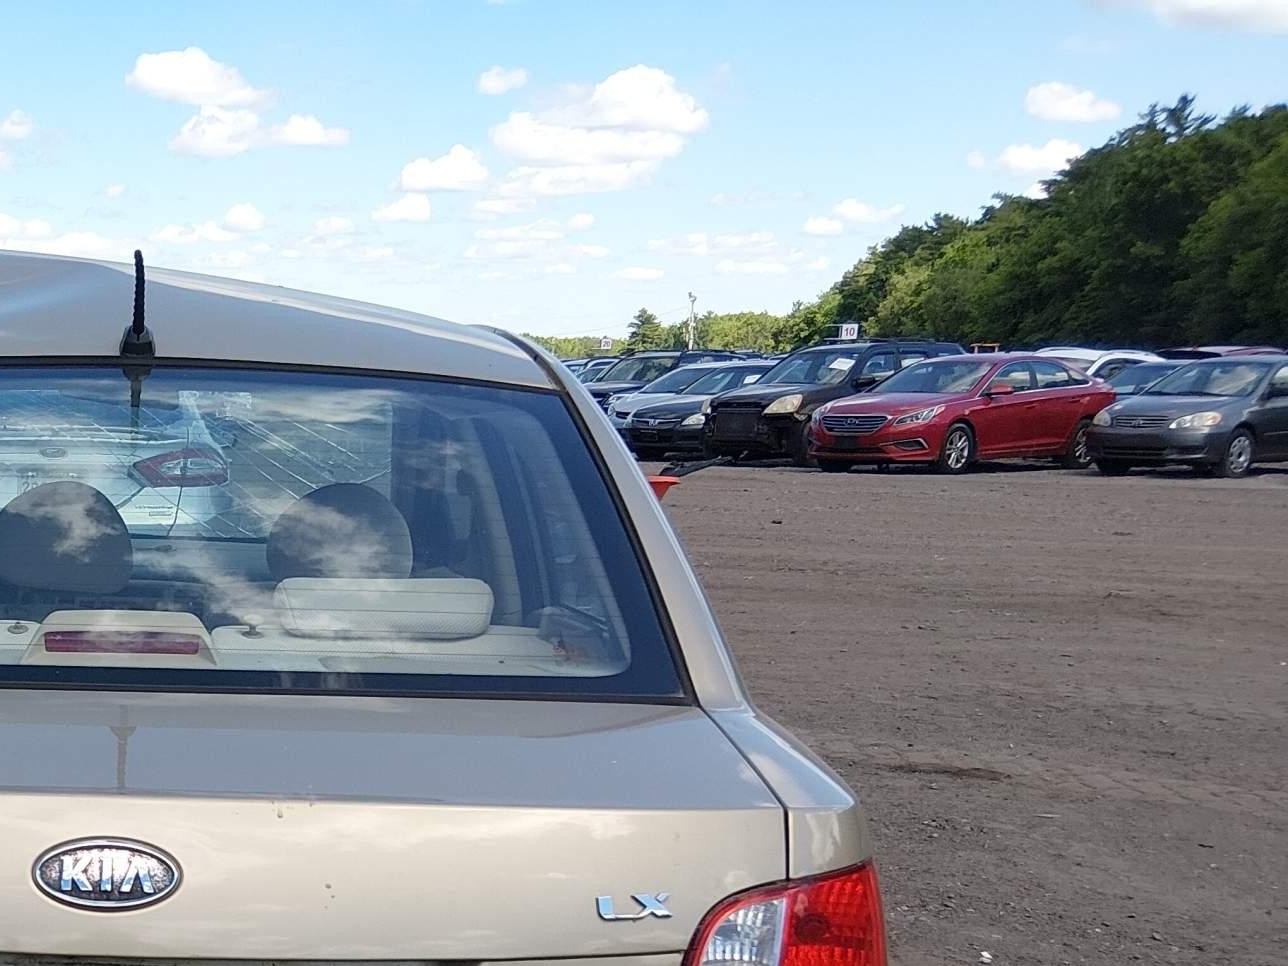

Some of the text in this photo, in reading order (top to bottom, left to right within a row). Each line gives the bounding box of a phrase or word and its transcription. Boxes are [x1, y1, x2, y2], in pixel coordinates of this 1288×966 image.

[844, 327, 855, 337] 10
[60, 850, 155, 893] KIA
[595, 892, 673, 922] LX
